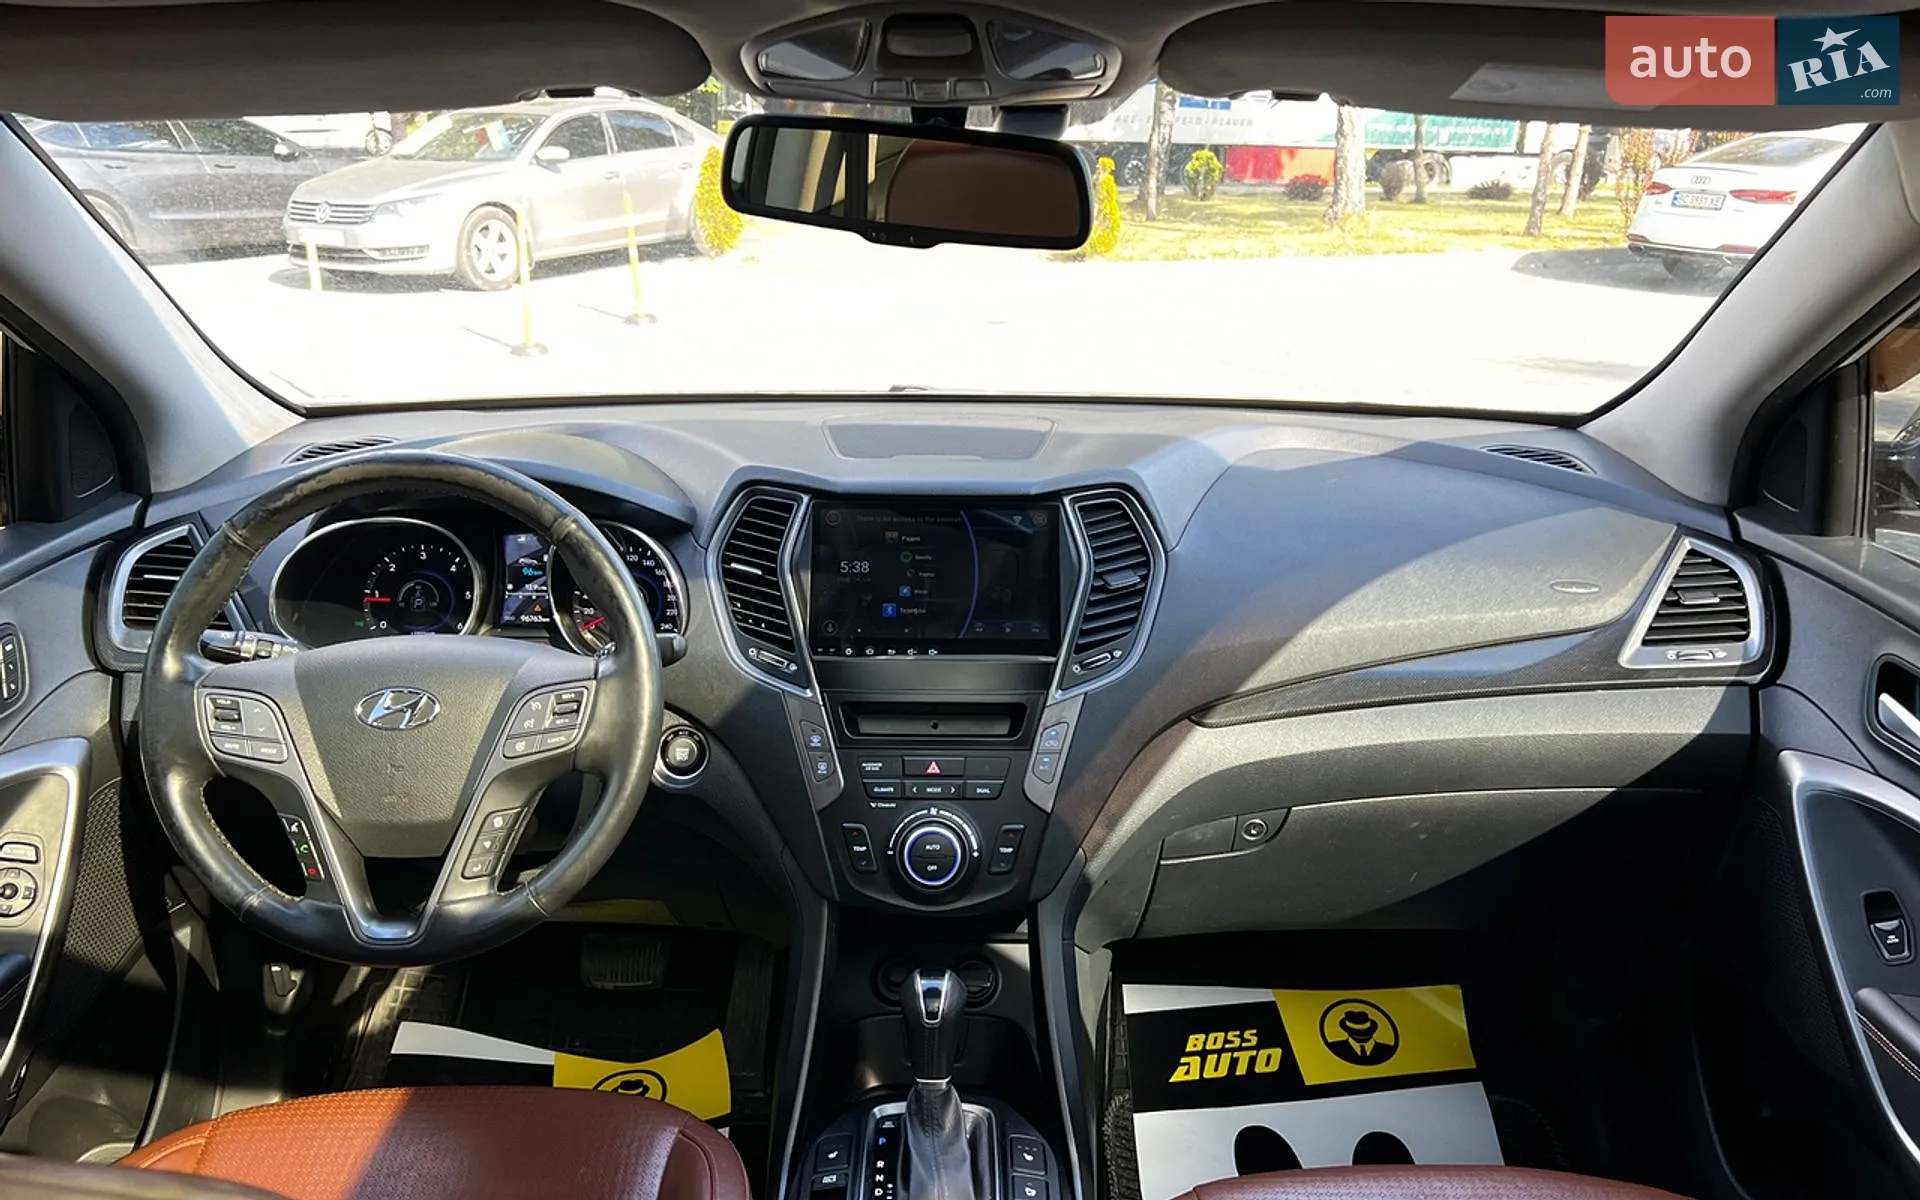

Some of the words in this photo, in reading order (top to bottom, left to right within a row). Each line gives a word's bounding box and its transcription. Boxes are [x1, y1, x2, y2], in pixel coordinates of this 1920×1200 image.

[419, 551, 428, 561] 3
[388, 562, 397, 573] 2
[450, 563, 458, 573] 4
[839, 560, 871, 574] 5:38
[465, 590, 472, 600] 5
[379, 619, 387, 630] 0
[924, 843, 941, 851] AUTO
[1185, 1029, 1258, 1052] BOSS
[1168, 1047, 1282, 1083] AUTO
[876, 1159, 885, 1169] R
[874, 1174, 884, 1182] N
[874, 1187, 884, 1197] D
